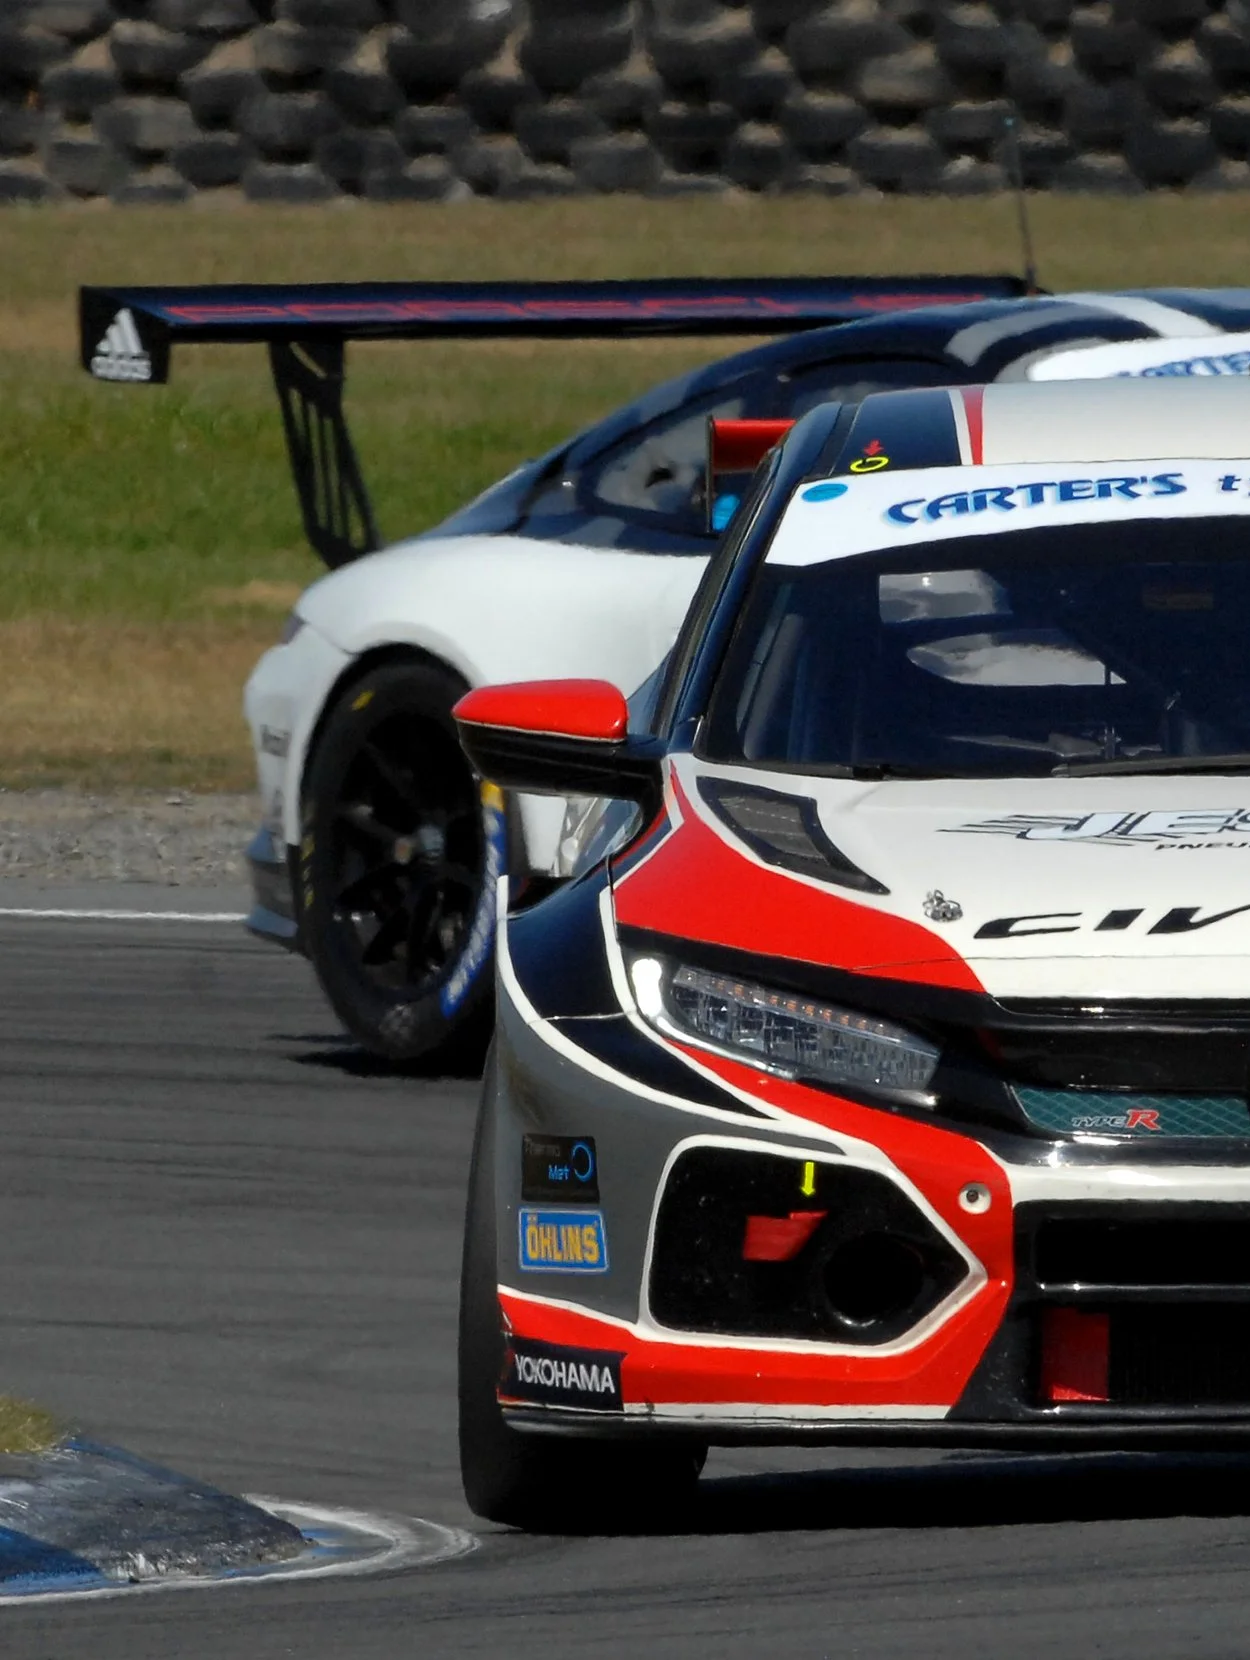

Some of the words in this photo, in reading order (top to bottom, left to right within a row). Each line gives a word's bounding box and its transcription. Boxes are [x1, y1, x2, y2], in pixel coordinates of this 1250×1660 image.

[887, 473, 1188, 524] CARTER'S
[526, 1214, 600, 1264] ÖHLINS
[515, 1353, 616, 1394] YOKOHAMA
